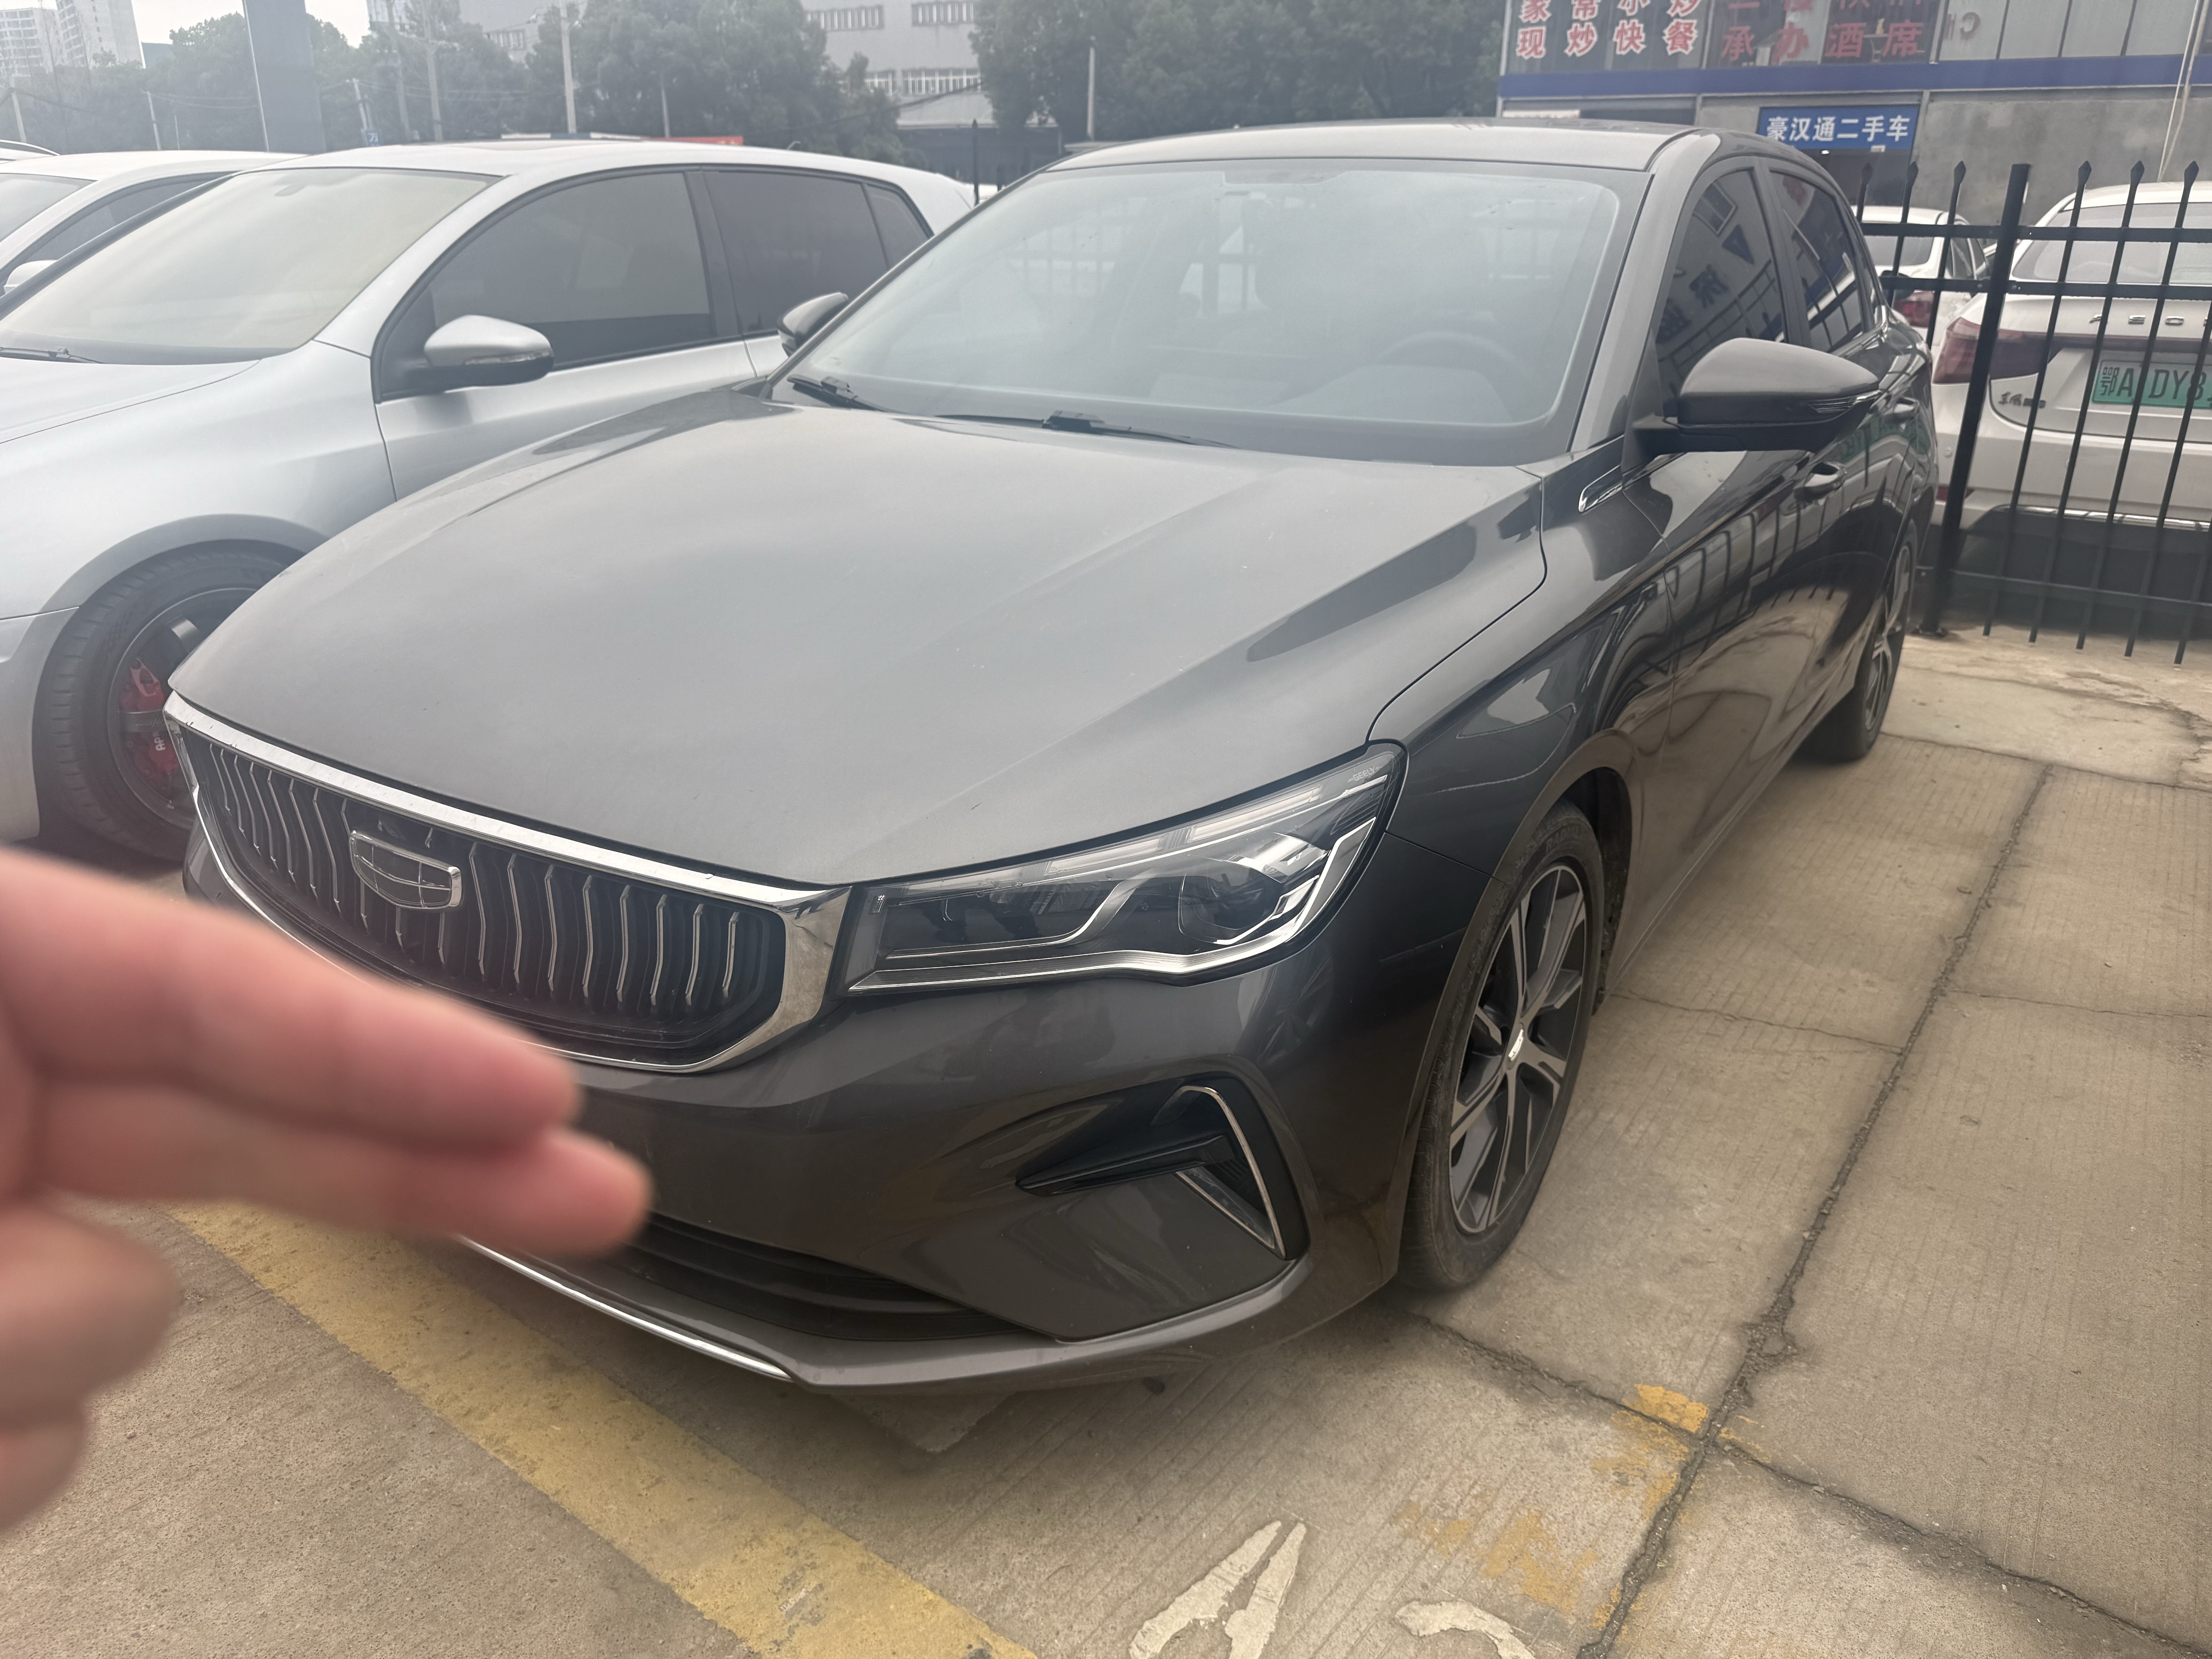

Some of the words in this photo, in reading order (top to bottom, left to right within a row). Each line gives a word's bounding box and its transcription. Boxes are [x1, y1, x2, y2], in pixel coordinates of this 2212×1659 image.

[1516, 19, 1698, 60] 现炒快餐
[1721, 19, 1924, 64] 承办酒席
[1766, 115, 1910, 142] 豪汉通二手车
[1353, 766, 1375, 781] GEELY
